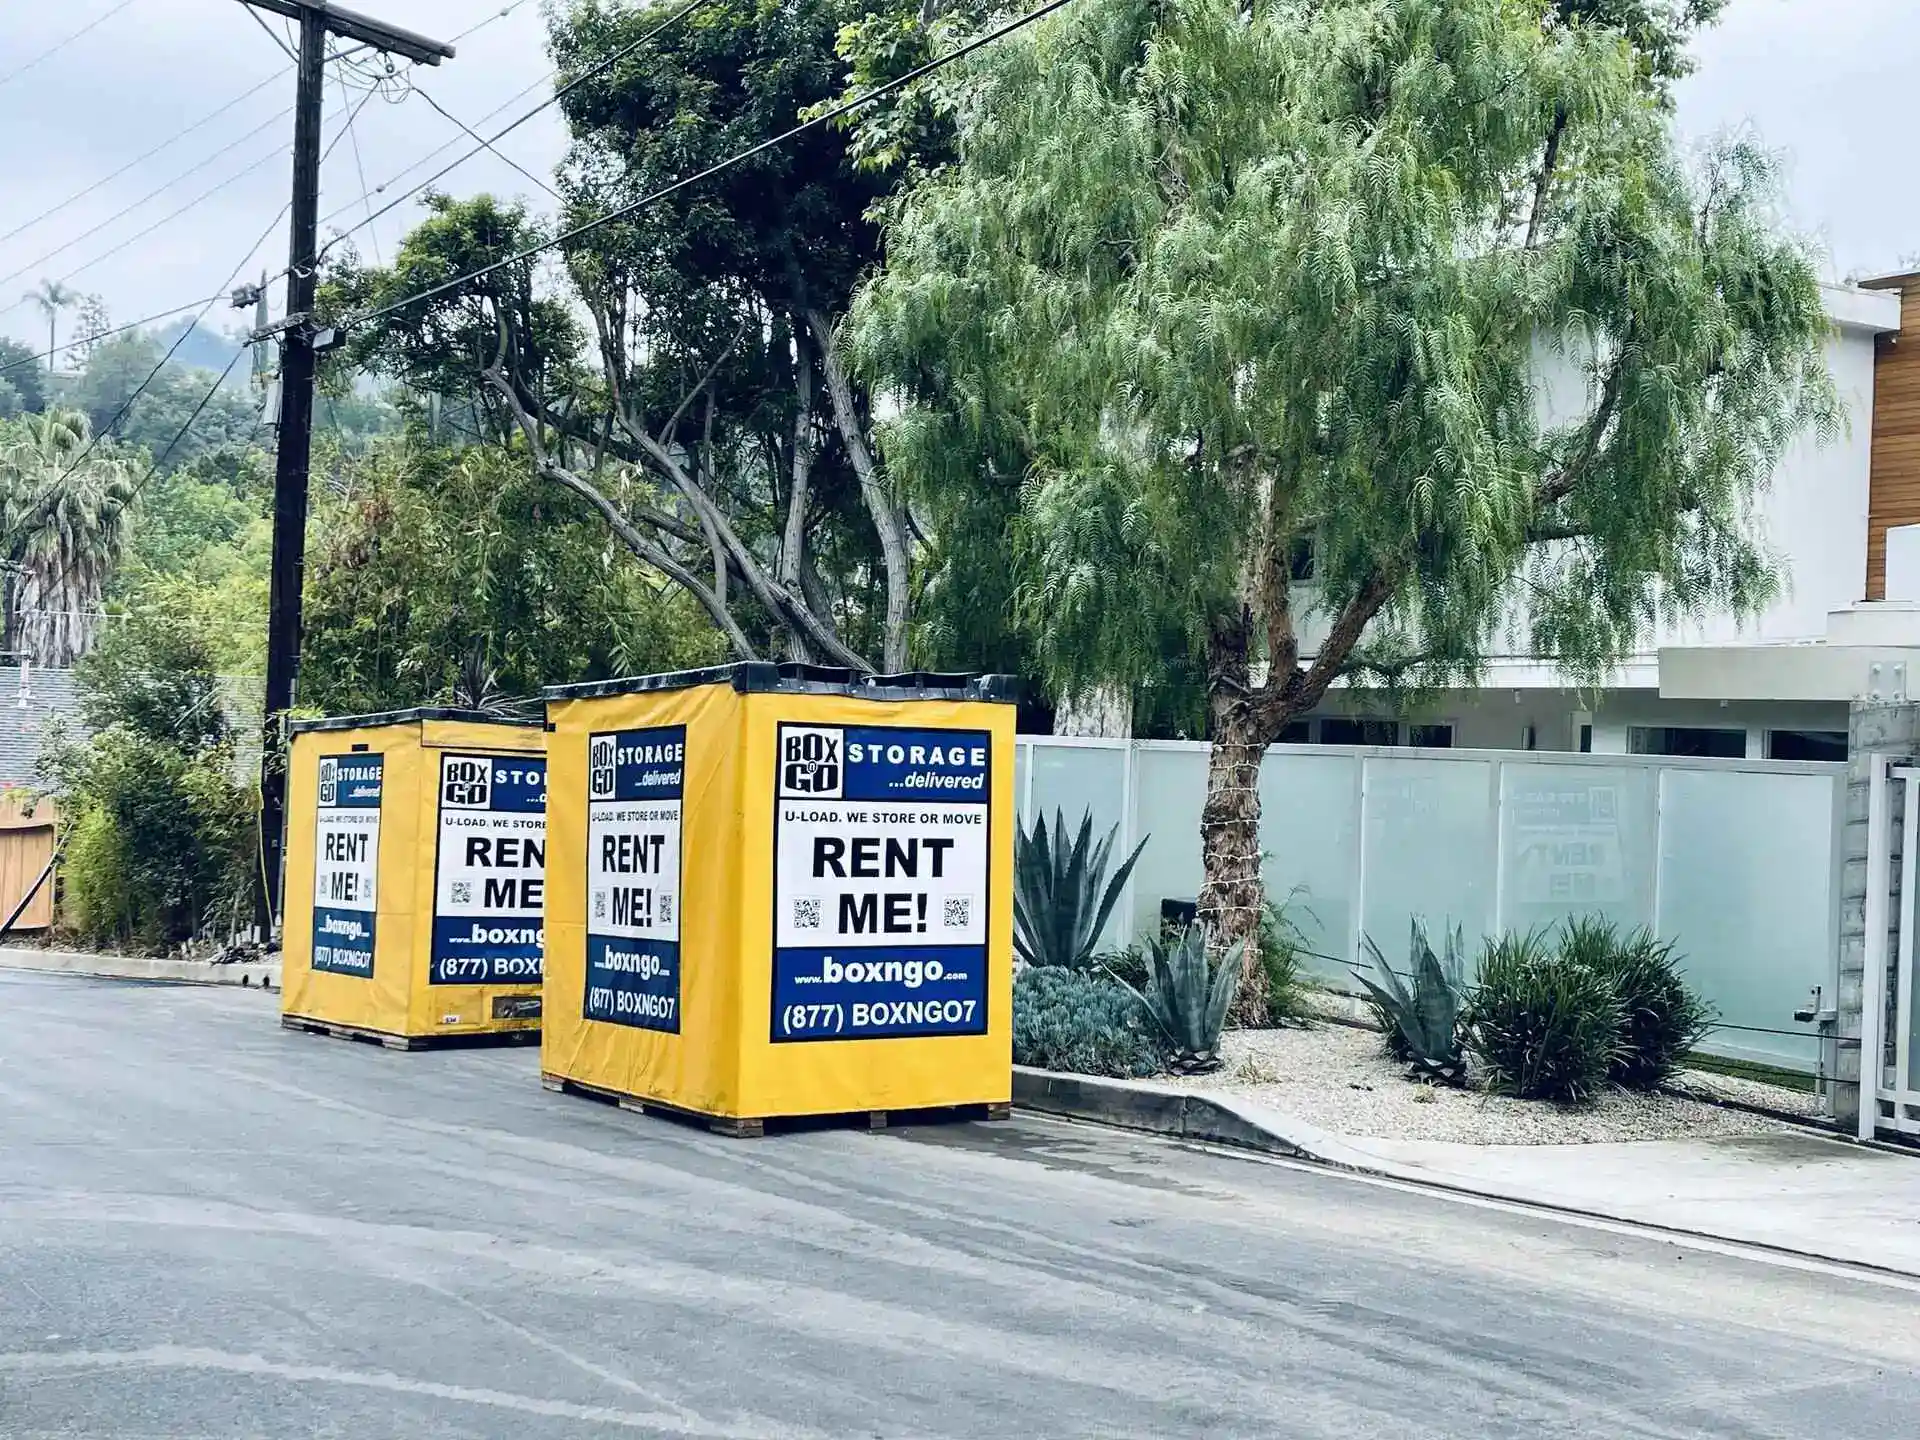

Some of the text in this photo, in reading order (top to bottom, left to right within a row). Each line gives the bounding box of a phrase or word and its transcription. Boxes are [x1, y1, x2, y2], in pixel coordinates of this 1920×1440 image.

[592, 741, 615, 768] BOX
[617, 743, 683, 765] STORAGE
[785, 733, 838, 763] BOX
[848, 743, 986, 767] STORAGE
[337, 766, 382, 781] STORAGE
[446, 762, 488, 784] BOX
[495, 769, 546, 785] STO
[592, 768, 614, 795] GO
[785, 763, 838, 793] GO
[889, 772, 984, 789] ...delivered
[446, 783, 487, 804] GO
[445, 817, 489, 827] U-LOAD.
[492, 819, 509, 828] WE
[616, 811, 626, 821] WE
[627, 810, 648, 821] STORE
[649, 810, 659, 820] OR
[660, 810, 678, 821] MOVE
[785, 811, 981, 825] U-LOAD. WE STORE OR MOVE
[325, 832, 369, 862] RENT
[602, 834, 665, 874] RENT
[812, 837, 954, 878] RENT
[331, 872, 359, 901] ME!
[612, 887, 652, 928] ME!
[838, 893, 928, 934] ME!
[332, 947, 372, 969] BOXNGO7
[440, 957, 544, 980] (877) BOX
[794, 956, 968, 988] www.boxngo.com
[590, 986, 675, 1019] (877) BOXNGO7
[783, 1000, 976, 1034] (877) BOXNGO7
